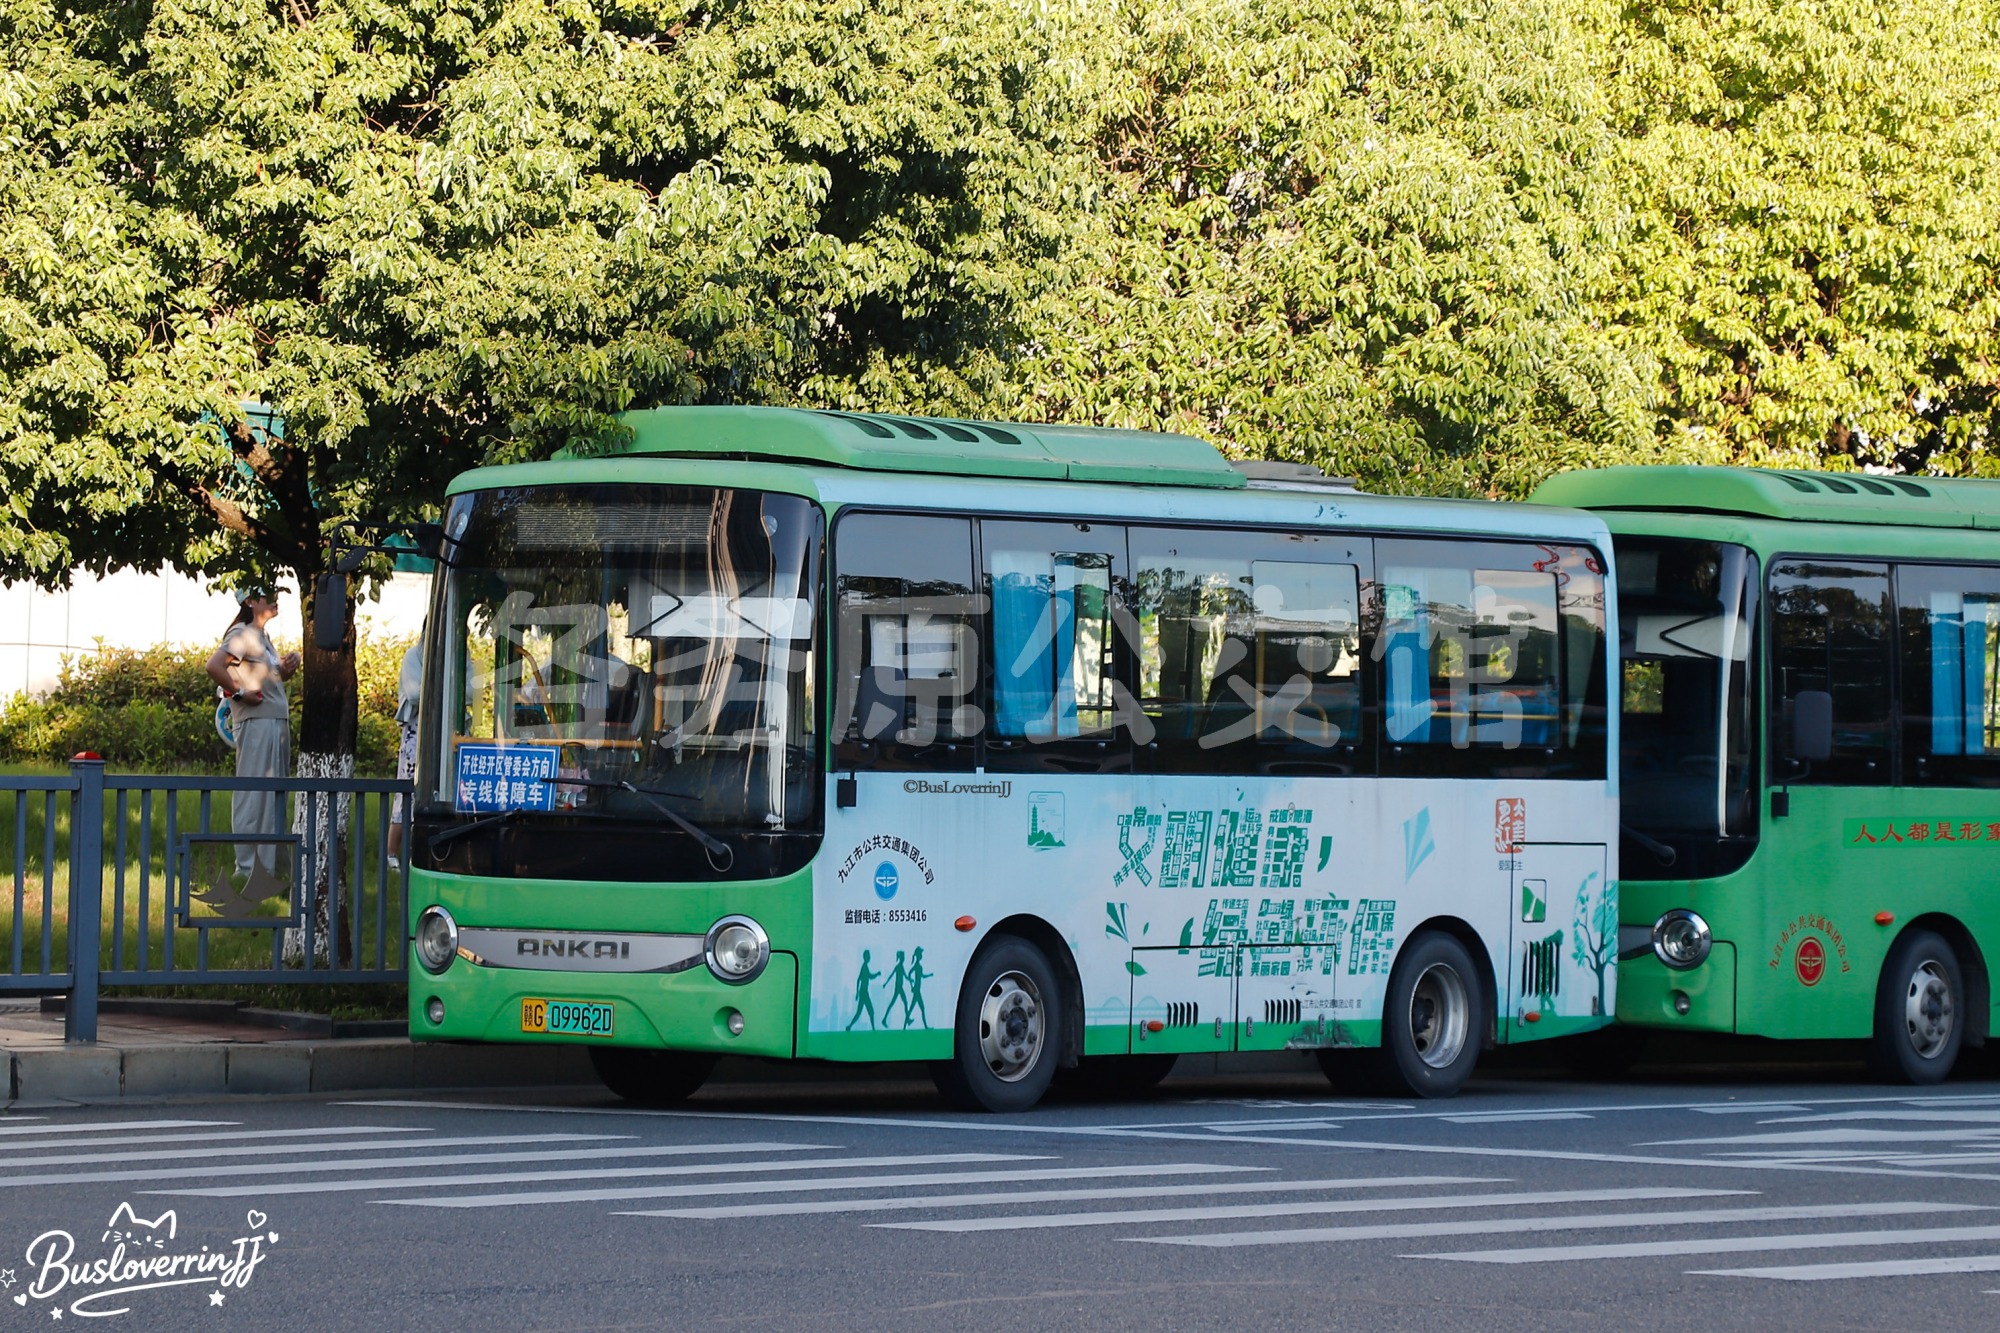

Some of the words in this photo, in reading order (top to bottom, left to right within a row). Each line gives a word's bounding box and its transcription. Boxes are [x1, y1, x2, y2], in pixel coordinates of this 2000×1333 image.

[462, 754, 550, 778] 开往经开区管委会方向
[464, 779, 544, 806] 专线保障车
[1853, 821, 2000, 843] 人人都是形象
[837, 834, 934, 885] 九江市公共交通集团公司
[517, 938, 630, 959] ANKAI
